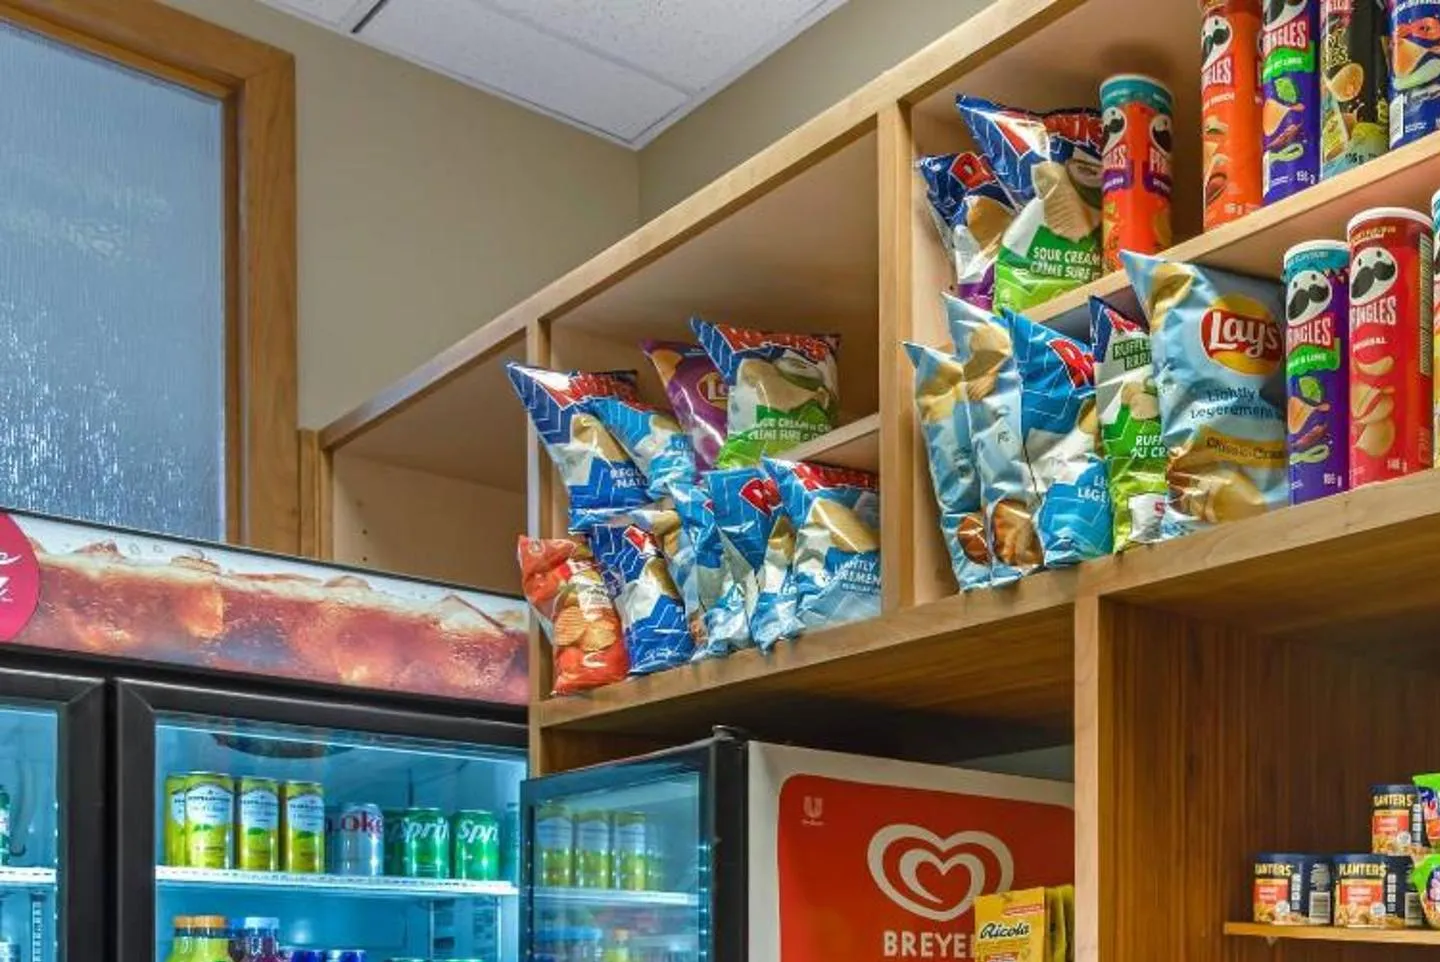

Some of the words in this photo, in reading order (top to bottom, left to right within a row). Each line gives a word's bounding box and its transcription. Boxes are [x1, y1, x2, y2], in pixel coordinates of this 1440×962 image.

[1034, 249, 1062, 261] SOUR
[980, 922, 1029, 940] Ricola
[883, 930, 975, 959] BREYE
